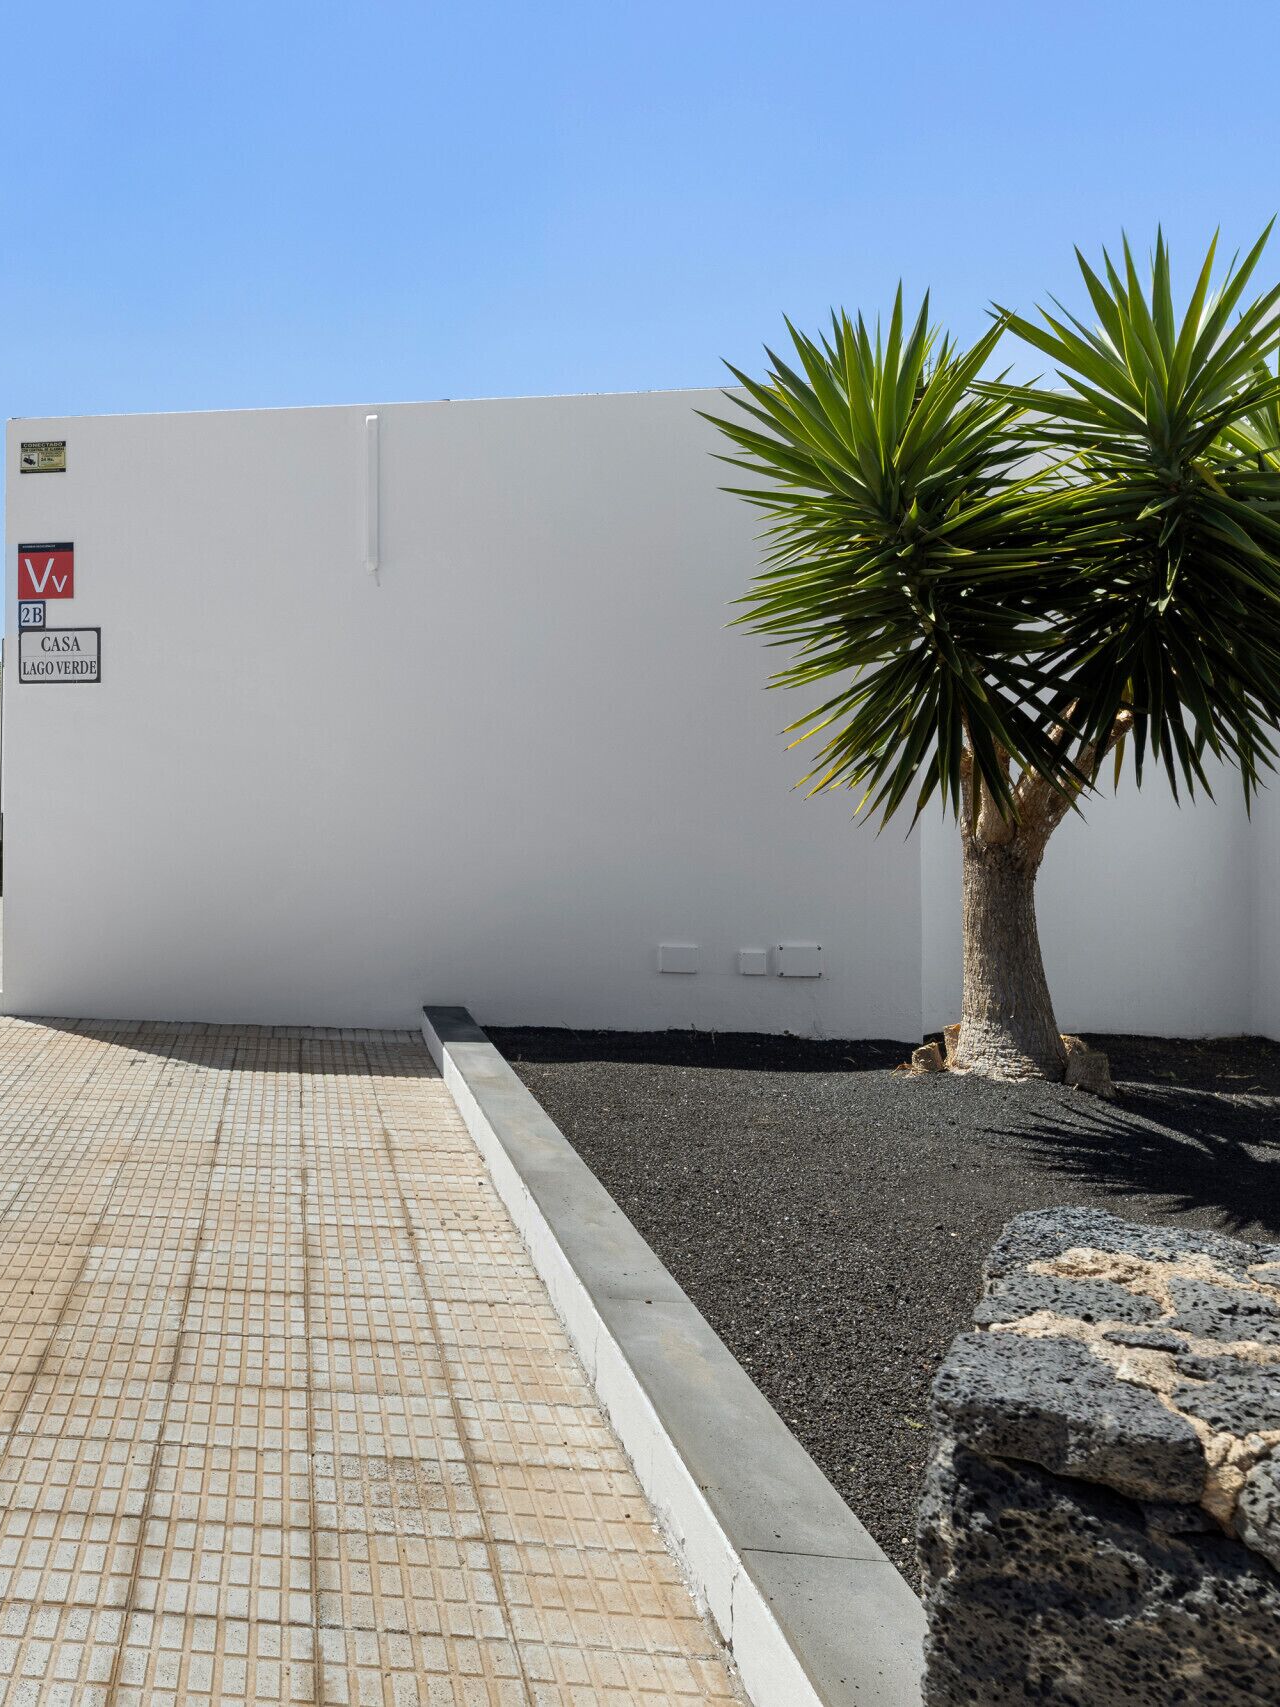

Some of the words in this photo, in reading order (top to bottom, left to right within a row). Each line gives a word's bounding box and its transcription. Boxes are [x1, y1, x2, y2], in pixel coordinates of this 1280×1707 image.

[21, 607, 43, 623] 2B
[41, 636, 81, 652] CASA
[22, 660, 54, 676] LAGO
[56, 660, 97, 675] VERDE
